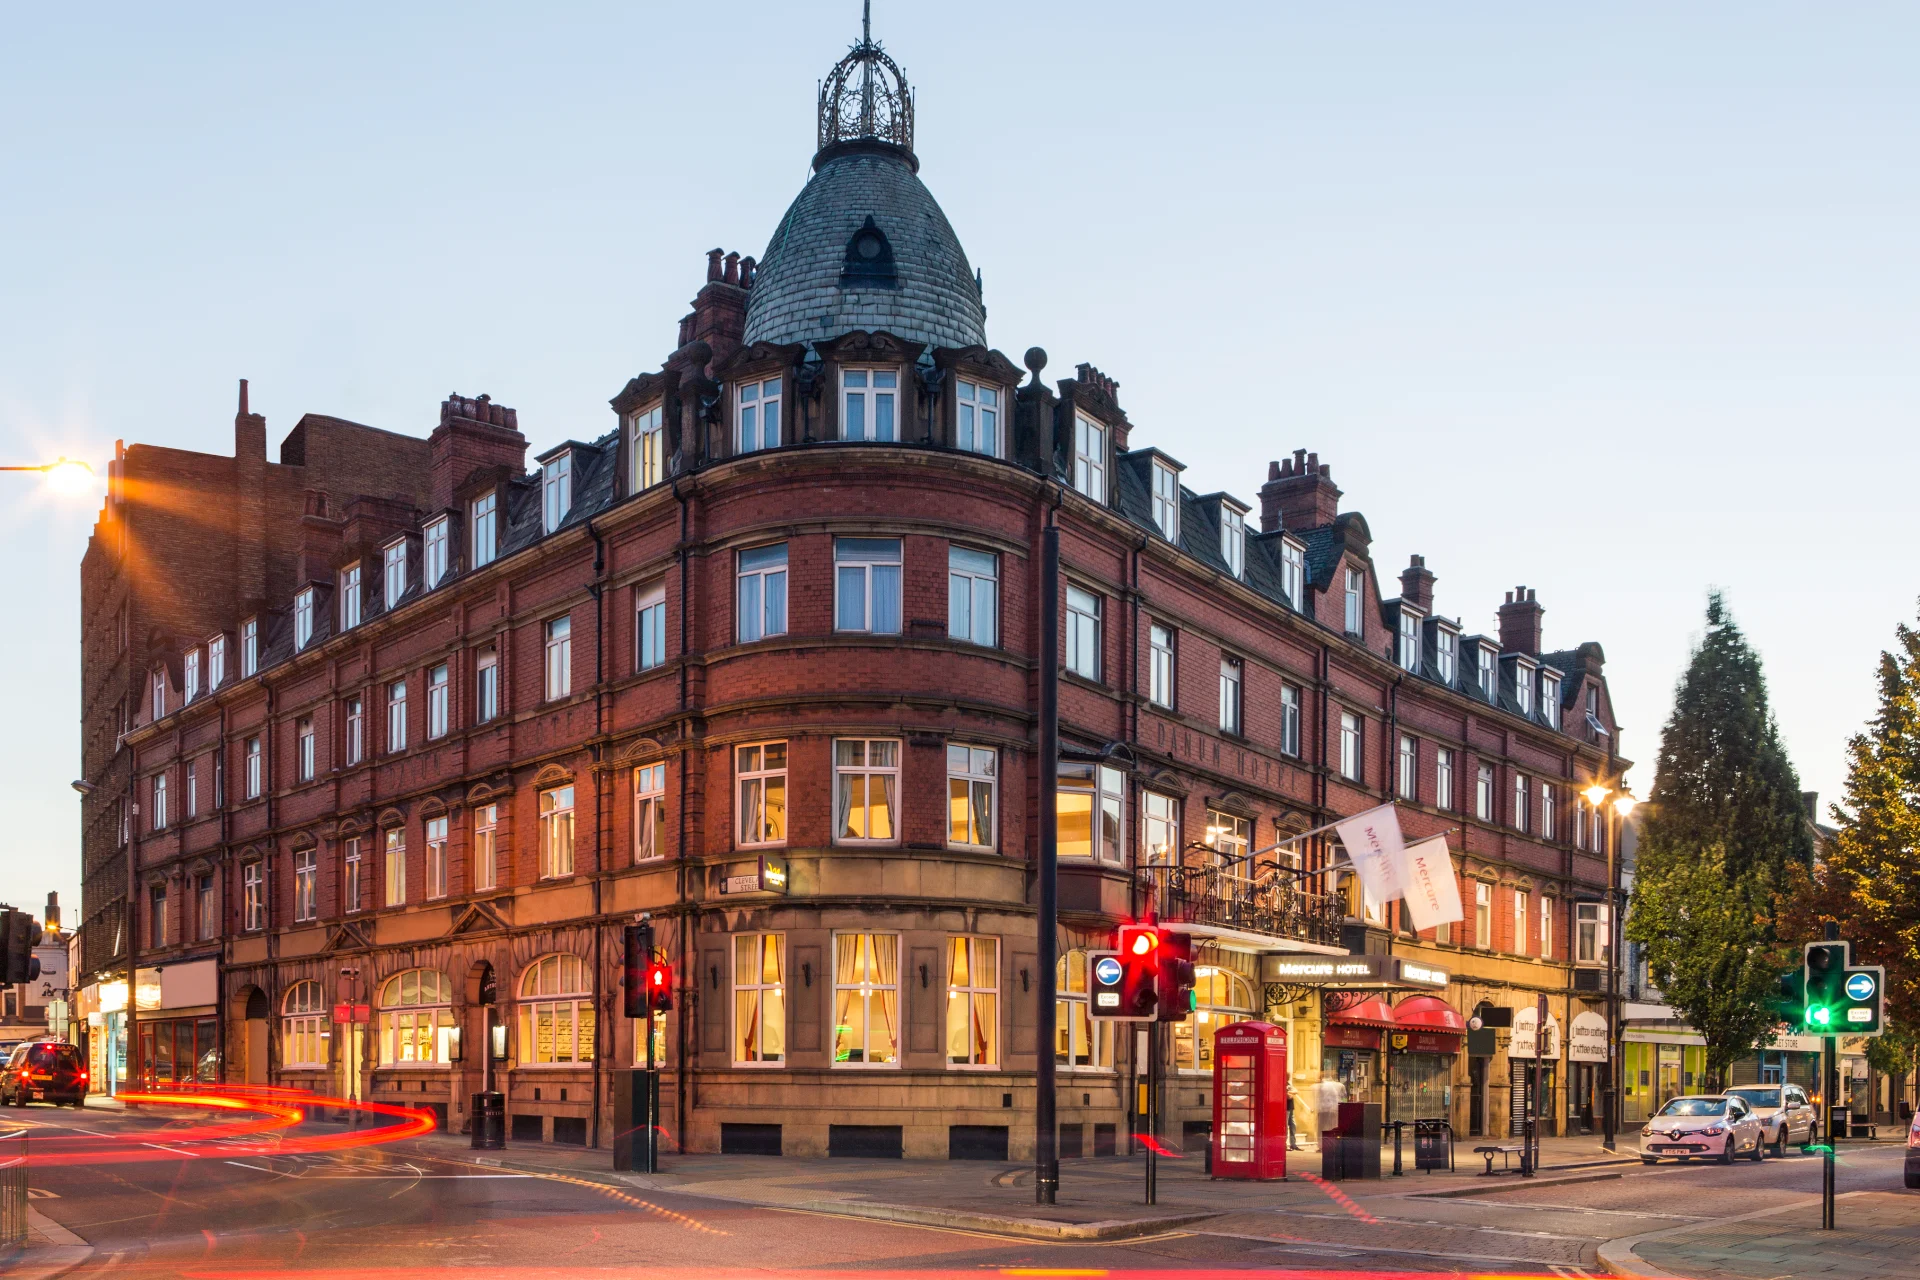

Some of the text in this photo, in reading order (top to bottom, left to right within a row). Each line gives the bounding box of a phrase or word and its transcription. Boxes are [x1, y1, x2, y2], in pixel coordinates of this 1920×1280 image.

[1415, 857, 1440, 912] Mercure
[1279, 963, 1371, 975] Mercure HOTEL
[1785, 1038, 1798, 1049] STORE
